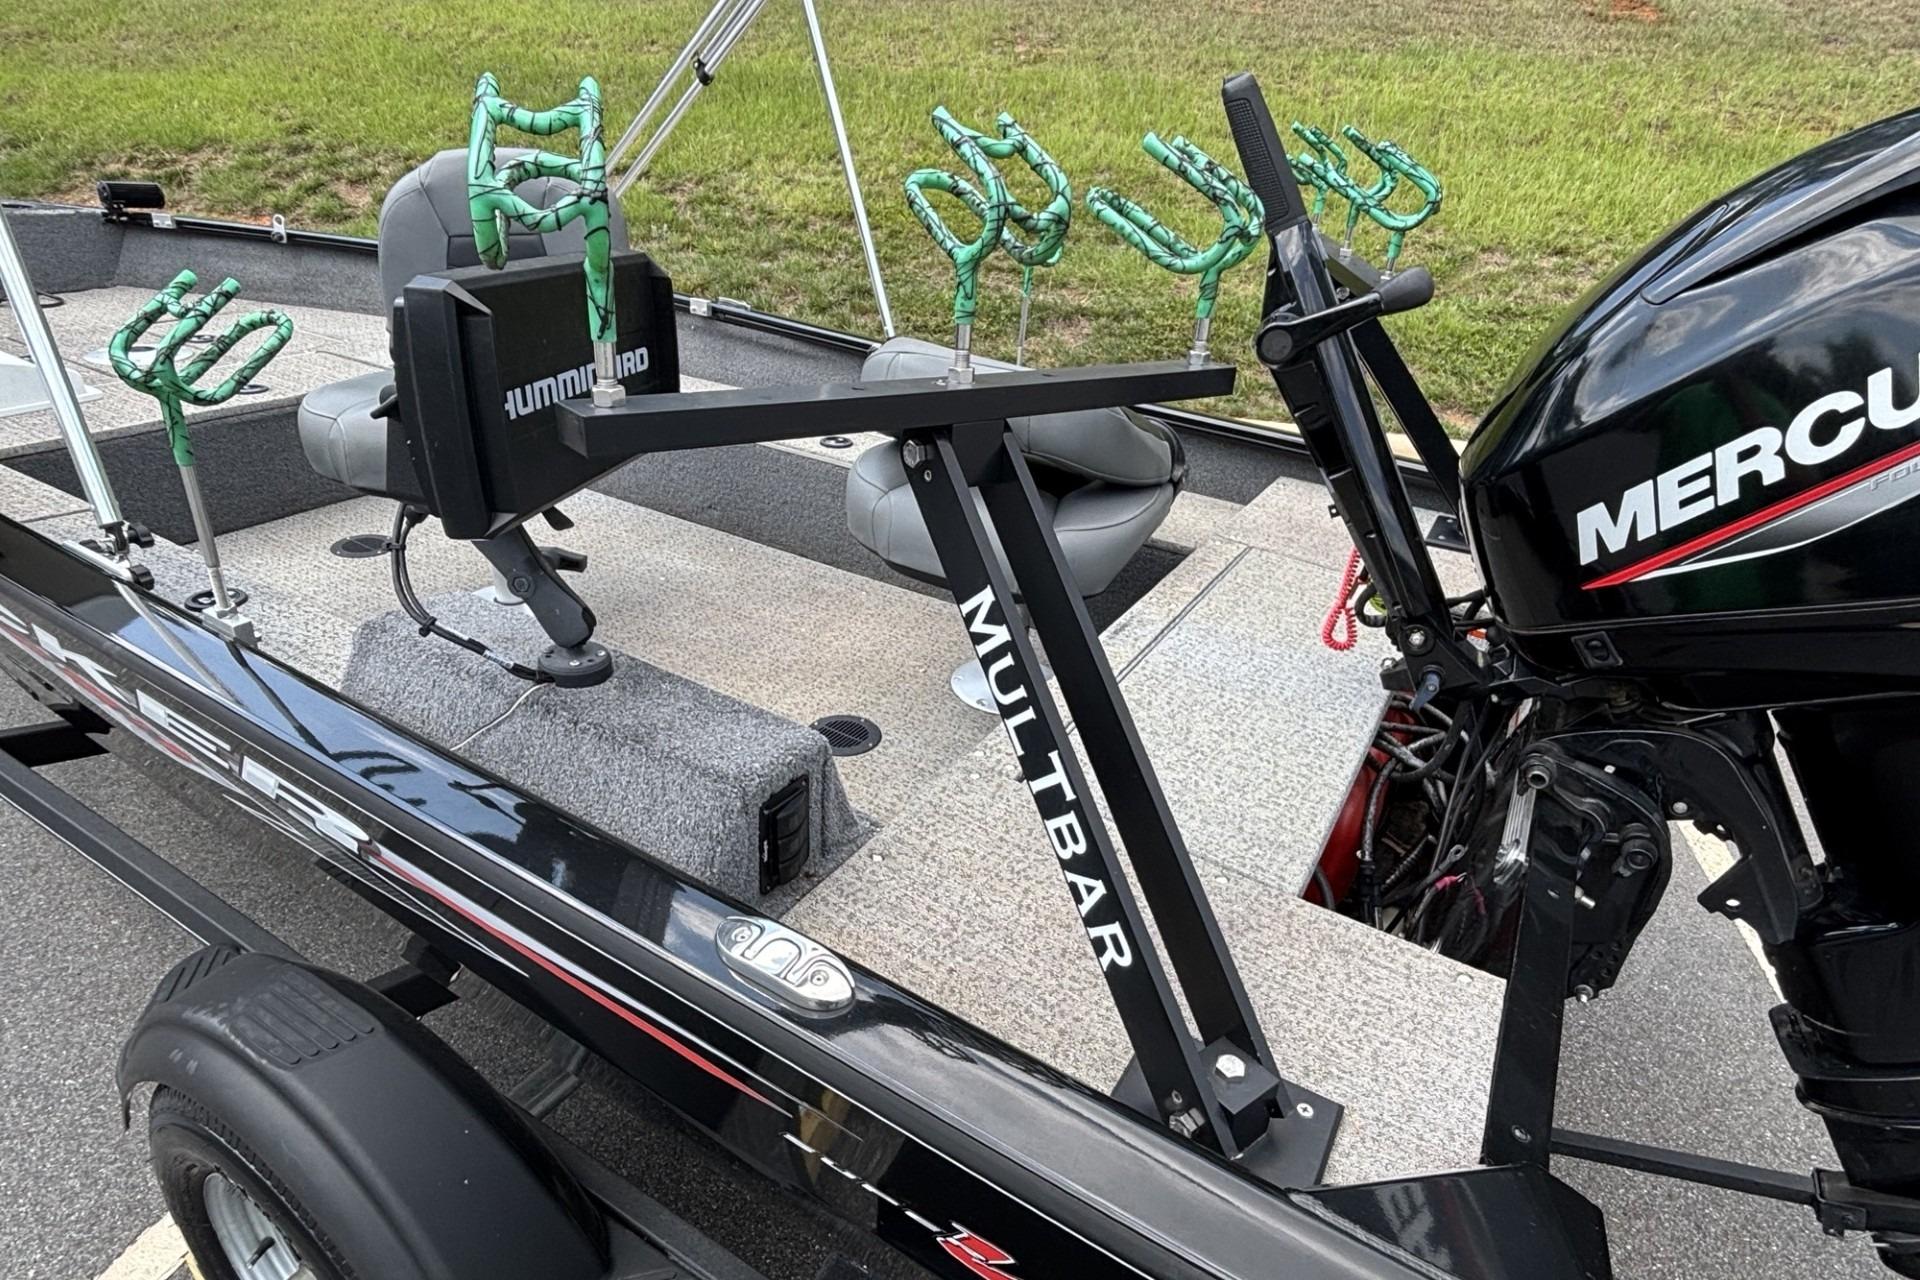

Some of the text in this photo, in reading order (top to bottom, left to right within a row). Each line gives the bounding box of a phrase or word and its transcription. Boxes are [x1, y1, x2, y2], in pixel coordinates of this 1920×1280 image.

[505, 346, 649, 420] HUMMINIRD
[1576, 367, 1920, 566] MERCU
[960, 584, 1133, 972] MULTBAR
